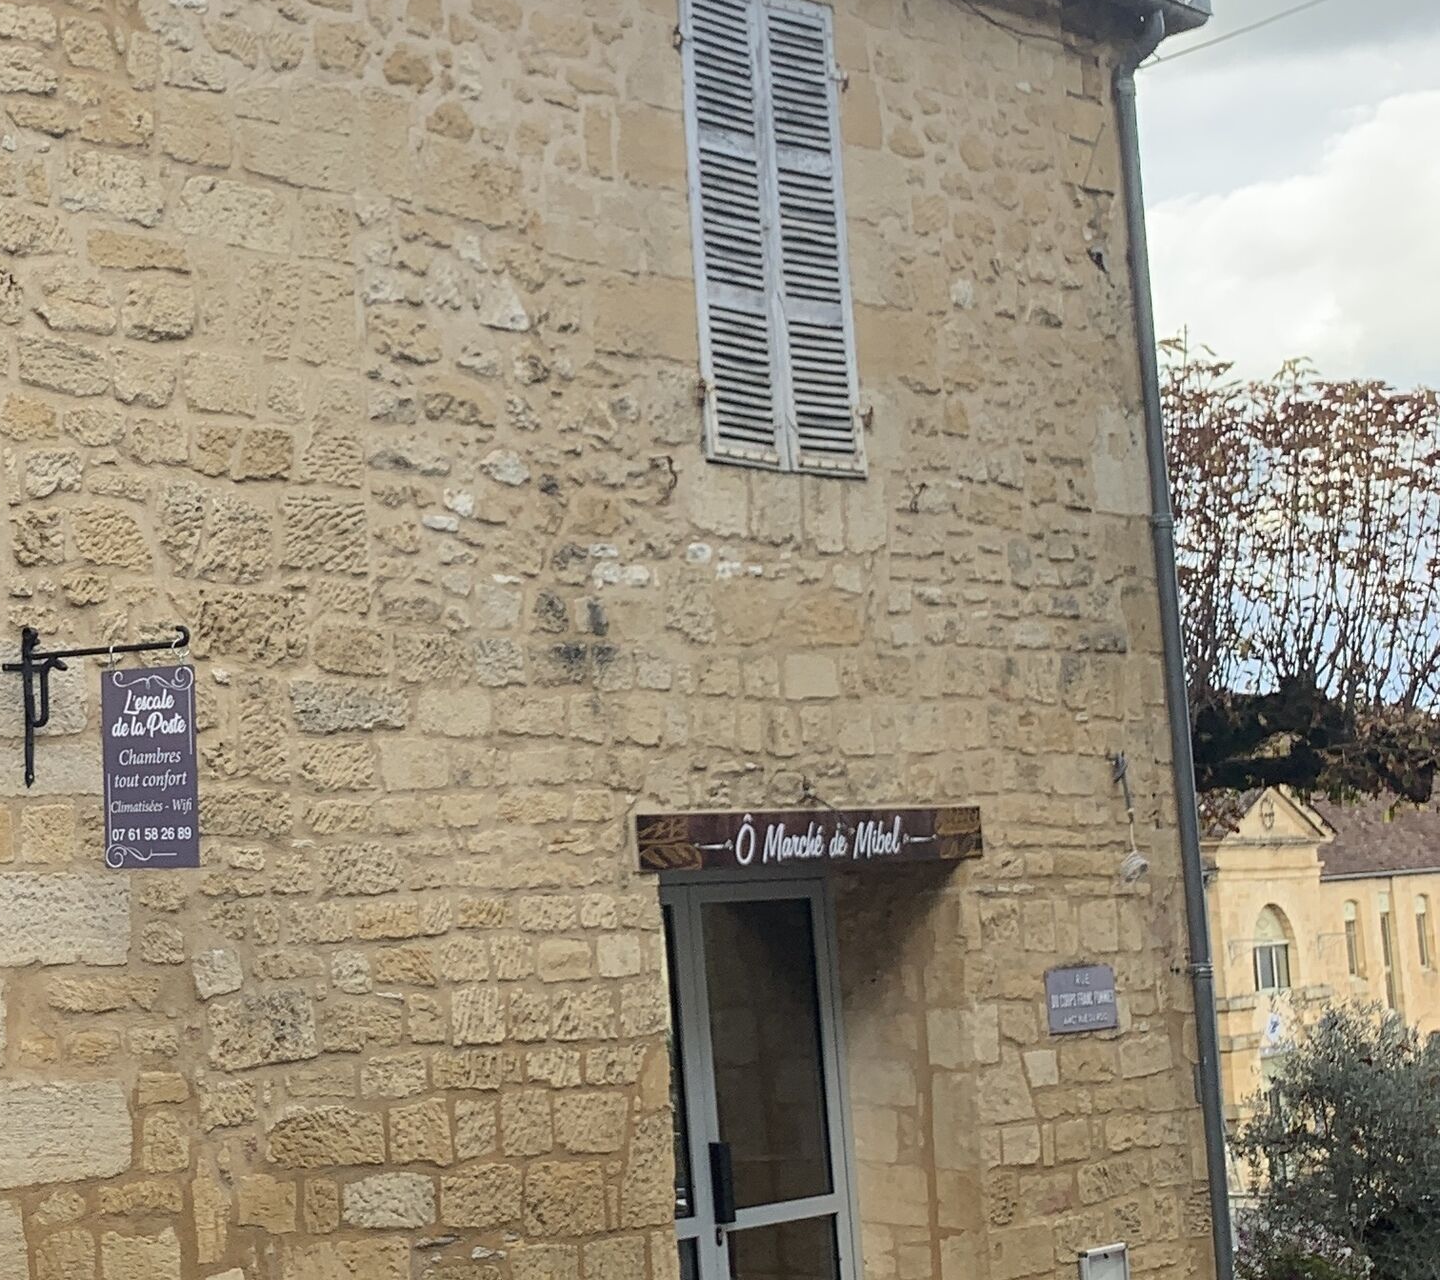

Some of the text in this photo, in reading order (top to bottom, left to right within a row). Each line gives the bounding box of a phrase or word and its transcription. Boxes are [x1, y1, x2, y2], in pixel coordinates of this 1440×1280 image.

[123, 689, 175, 715] L'escale
[112, 712, 186, 738] de la Poste
[119, 747, 181, 766] Chambres
[114, 770, 187, 791] tout confort
[111, 799, 163, 813] Climatisées
[172, 798, 192, 815] Wifi
[112, 826, 192, 841] 07 61 58 26 89
[735, 813, 901, 865] Ô Marché de Mibel
